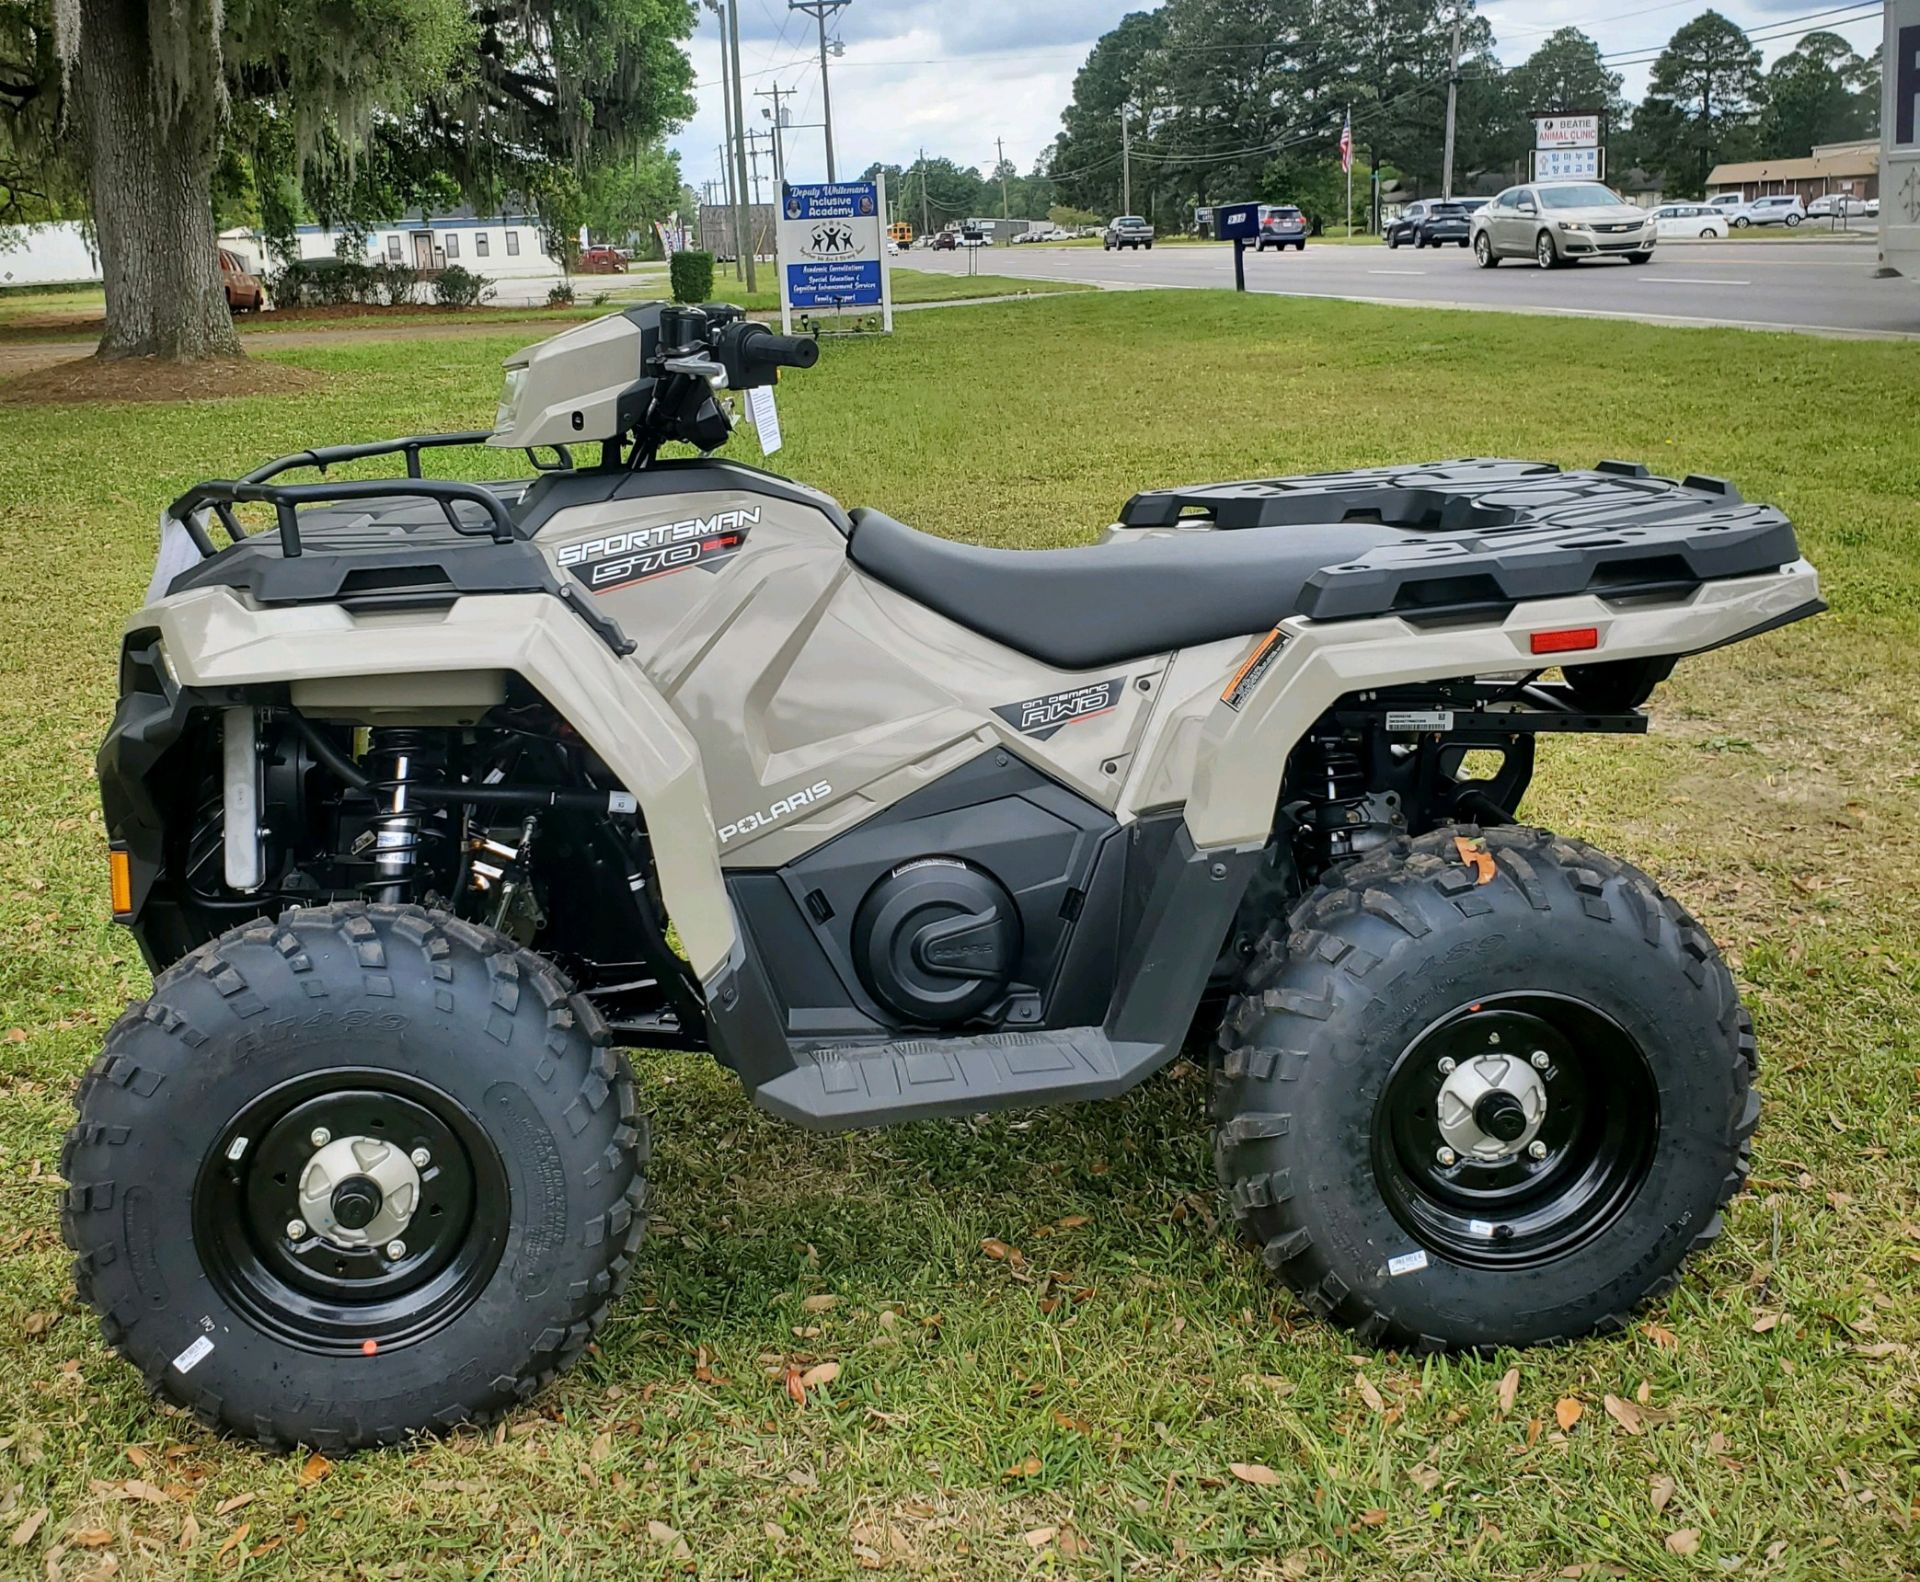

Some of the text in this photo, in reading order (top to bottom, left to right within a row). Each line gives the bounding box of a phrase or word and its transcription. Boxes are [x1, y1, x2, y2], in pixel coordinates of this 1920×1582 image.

[1560, 120, 1591, 128] BEATIE
[1540, 130, 1596, 140] ANIMAL CLINIC
[790, 184, 869, 199] Deputy Whiteman's
[810, 197, 851, 206] Inclusive
[809, 207, 854, 218] Academy
[803, 265, 828, 273] Academic
[808, 275, 827, 284] Special
[793, 282, 876, 293] Cognitive Enhancement Services
[814, 294, 833, 303] Family
[557, 506, 762, 567] SPORTSMAN
[591, 541, 701, 585] 570
[1022, 683, 1110, 710] ON DEMAND
[1021, 691, 1110, 728] AWD
[717, 779, 833, 844] POLARIS
